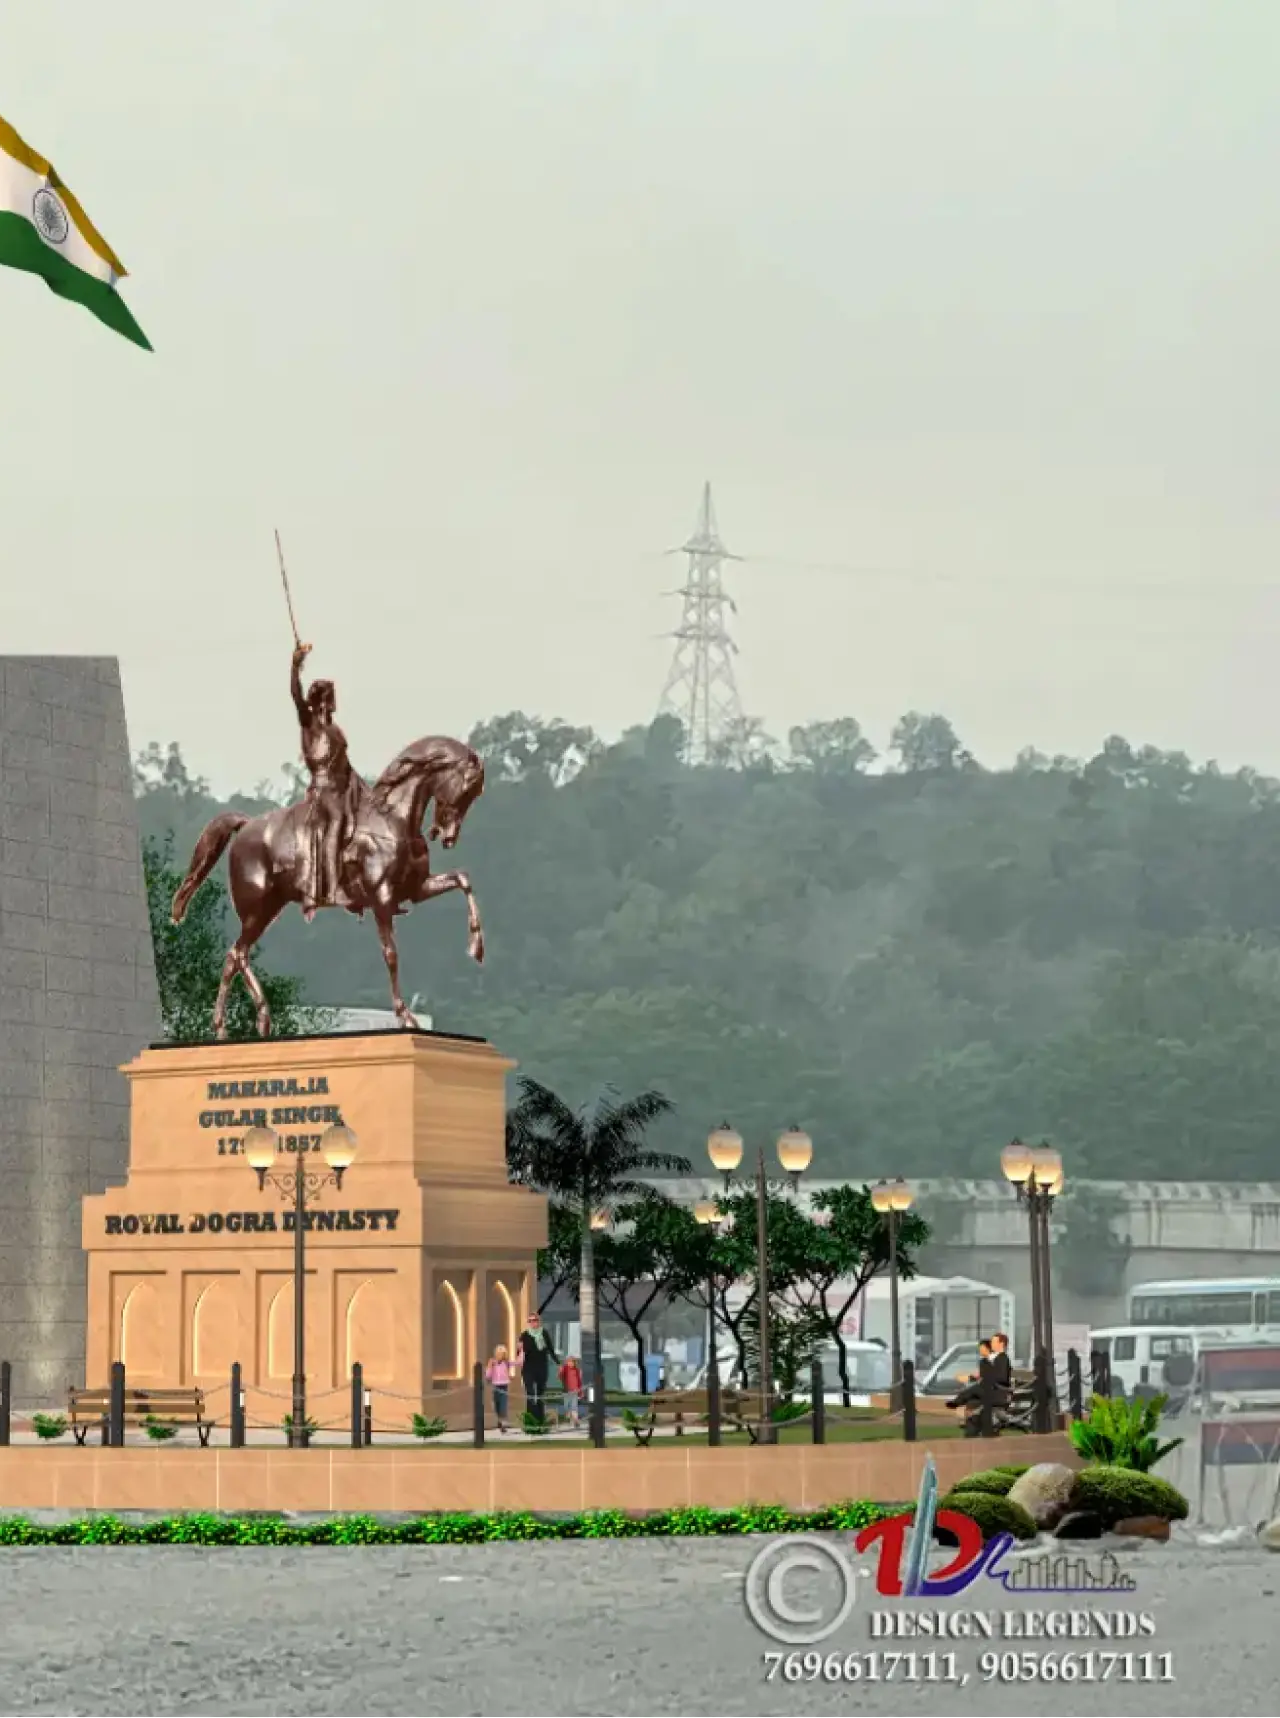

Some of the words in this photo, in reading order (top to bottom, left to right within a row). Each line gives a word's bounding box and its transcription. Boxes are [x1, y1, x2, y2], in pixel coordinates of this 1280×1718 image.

[207, 1076, 329, 1100] MAHARAJA
[272, 1104, 340, 1124] SINGH
[105, 1214, 184, 1234] ROYAL
[189, 1212, 276, 1233] DOGRA
[282, 1209, 400, 1232] DYNASTY
